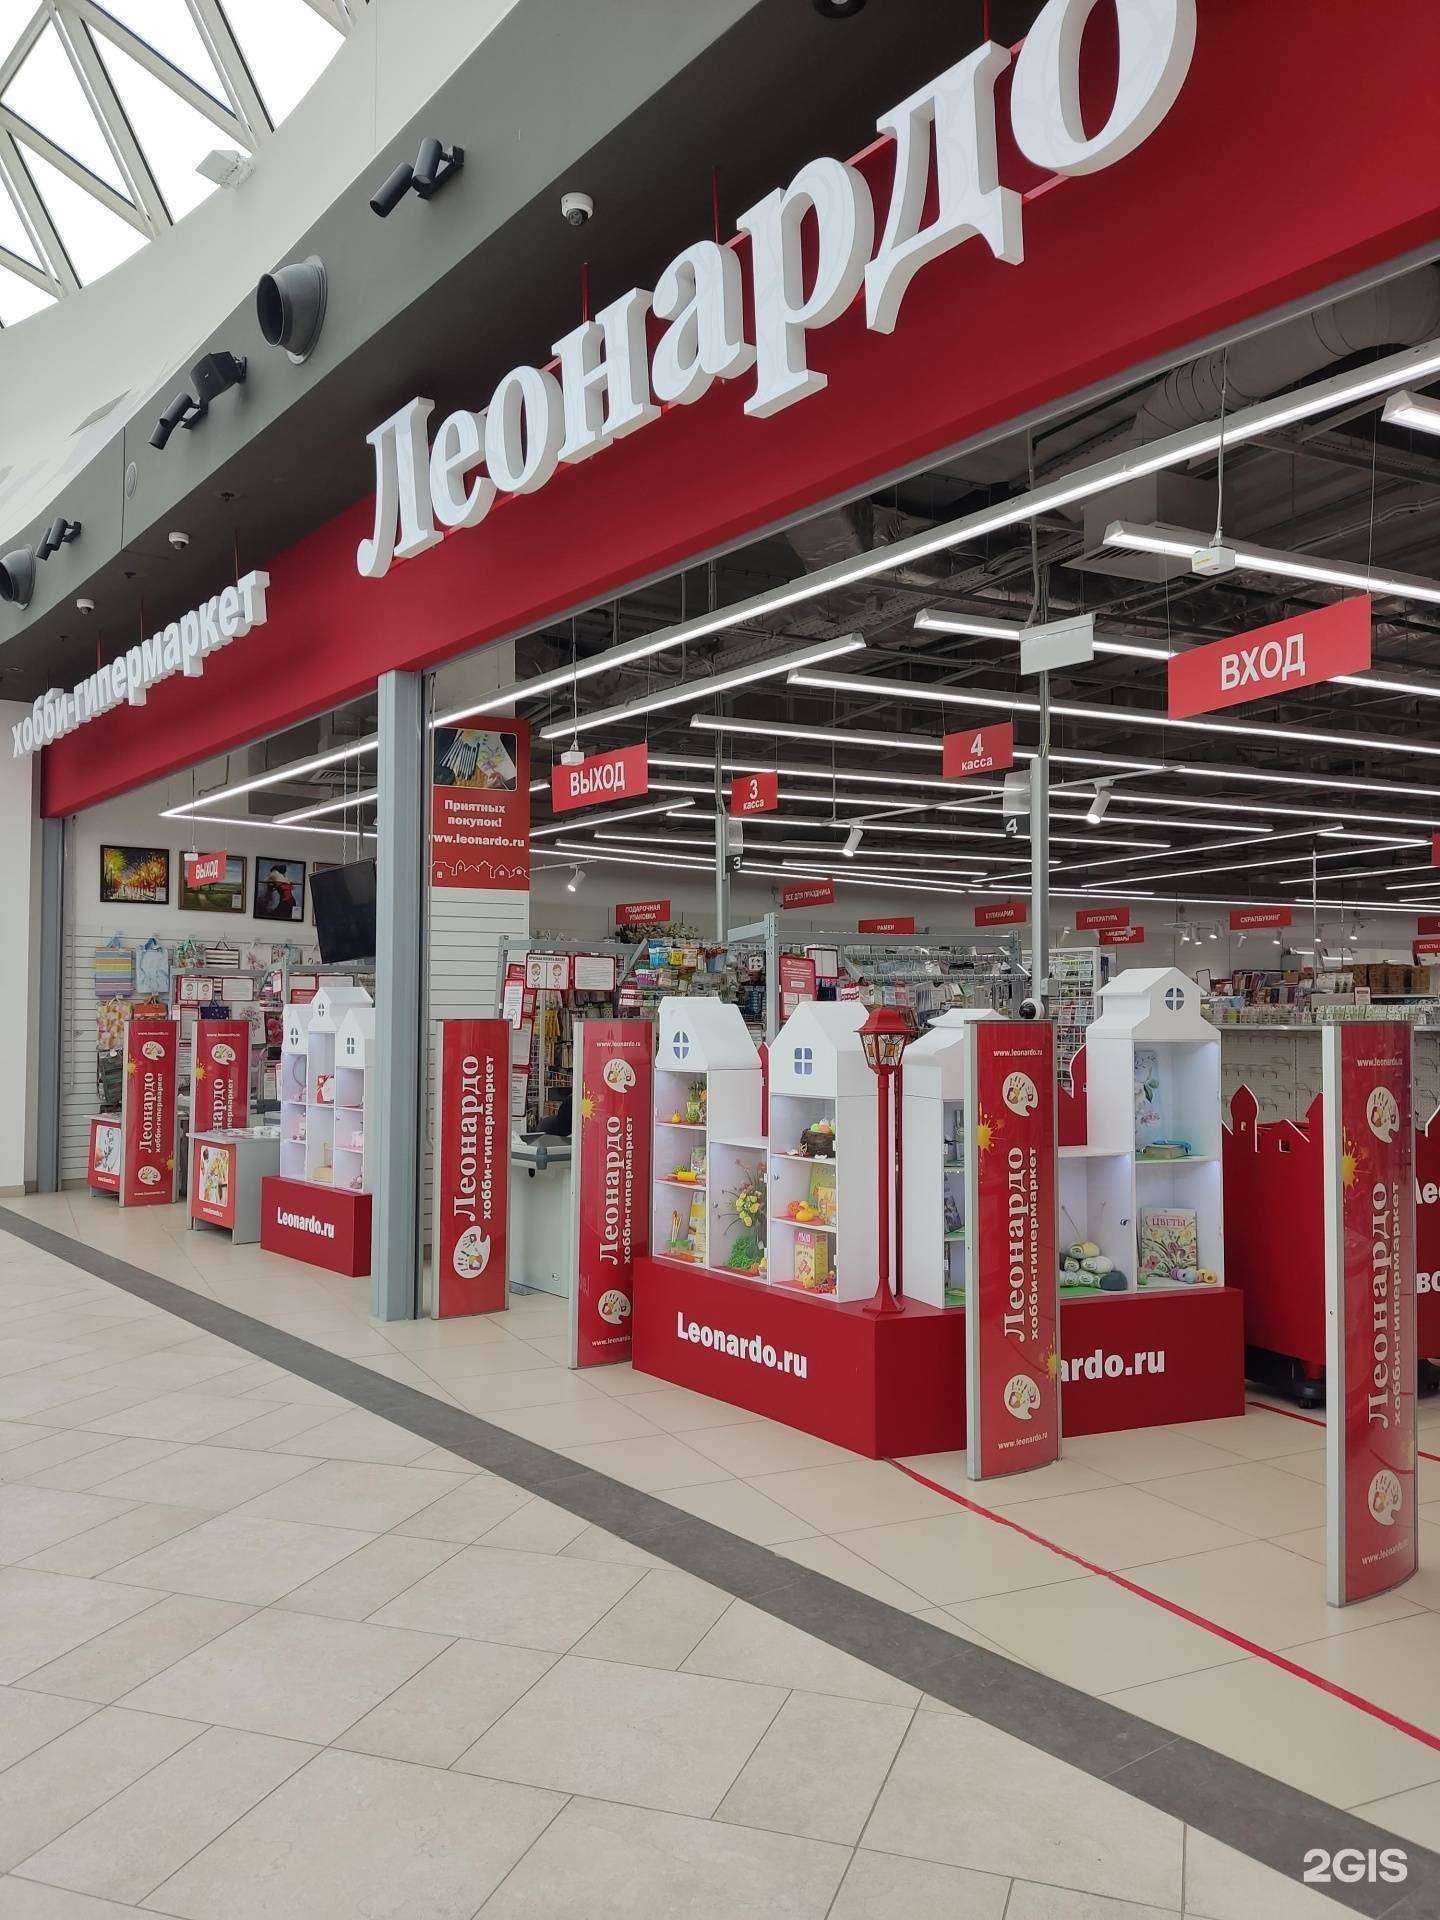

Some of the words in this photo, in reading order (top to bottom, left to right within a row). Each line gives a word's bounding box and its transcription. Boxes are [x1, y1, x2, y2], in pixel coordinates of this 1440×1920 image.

[357, 0, 1197, 578] Леонардо
[11, 570, 270, 758] хобби-гипермаркет
[1221, 633, 1306, 691] ВХОД
[970, 733, 984, 757] 4
[570, 761, 626, 797] ВЫХОД
[960, 755, 993, 770] касса
[444, 799, 506, 814] Приятных
[742, 798, 765, 810] касса
[749, 779, 758, 800] 3
[447, 816, 502, 828] покупок!
[1005, 818, 1018, 835] 4
[195, 860, 219, 880] ВЫХОД
[733, 856, 741, 870] 3
[1240, 913, 1281, 923] СКРАПБУКИНГ
[993, 1048, 1043, 1057] www.leonardo.ru
[140, 1072, 158, 1154] Леонардо
[453, 1056, 483, 1221] Леонардо
[482, 1055, 495, 1220] хобби-гипермаркет
[600, 1116, 625, 1265] Леонардо
[623, 1116, 634, 1265] хобби-гипермаркет
[277, 1206, 335, 1239] Leonardo.ru
[1152, 1217, 1186, 1227] ЦВЕТЫ
[1003, 1147, 1032, 1343] Леонардо
[1030, 1146, 1039, 1341] хобби-гипермаркет
[1368, 1182, 1391, 1430] Леонардо
[1391, 1181, 1401, 1426] хобби-гипермаркет
[676, 1311, 808, 1380] Leonardo.ru
[1060, 1349, 1165, 1382] ardo.ru
